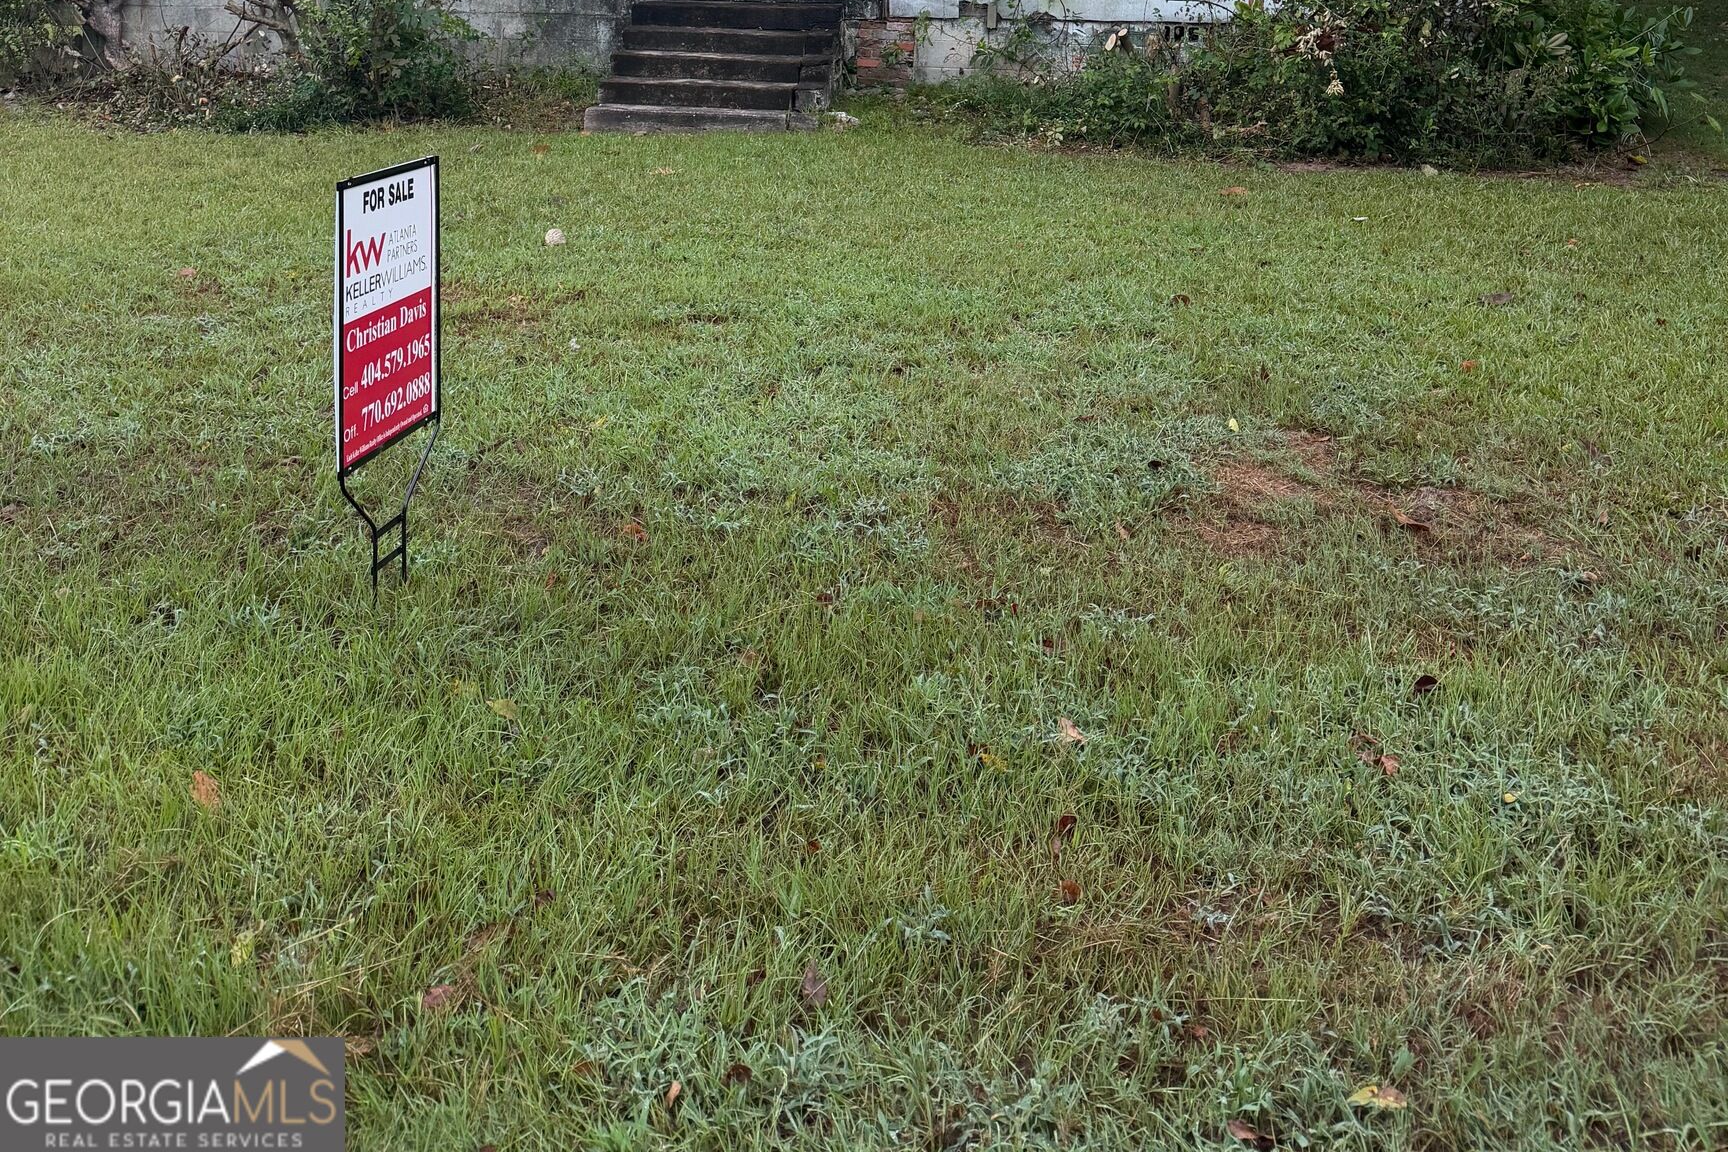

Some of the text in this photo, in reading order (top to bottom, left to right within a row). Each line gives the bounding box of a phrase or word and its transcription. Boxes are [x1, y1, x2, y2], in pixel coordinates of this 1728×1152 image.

[363, 178, 414, 214] FOR SALE
[346, 228, 386, 278] kw
[387, 239, 418, 263] PARTNERS
[388, 224, 417, 246] ATLANTA
[345, 288, 393, 318] REALTY
[346, 298, 427, 352] Christian Davis
[343, 333, 430, 400] Cell 404.579.1965
[343, 424, 359, 443] Off.
[361, 371, 430, 432] 770.692.0888
